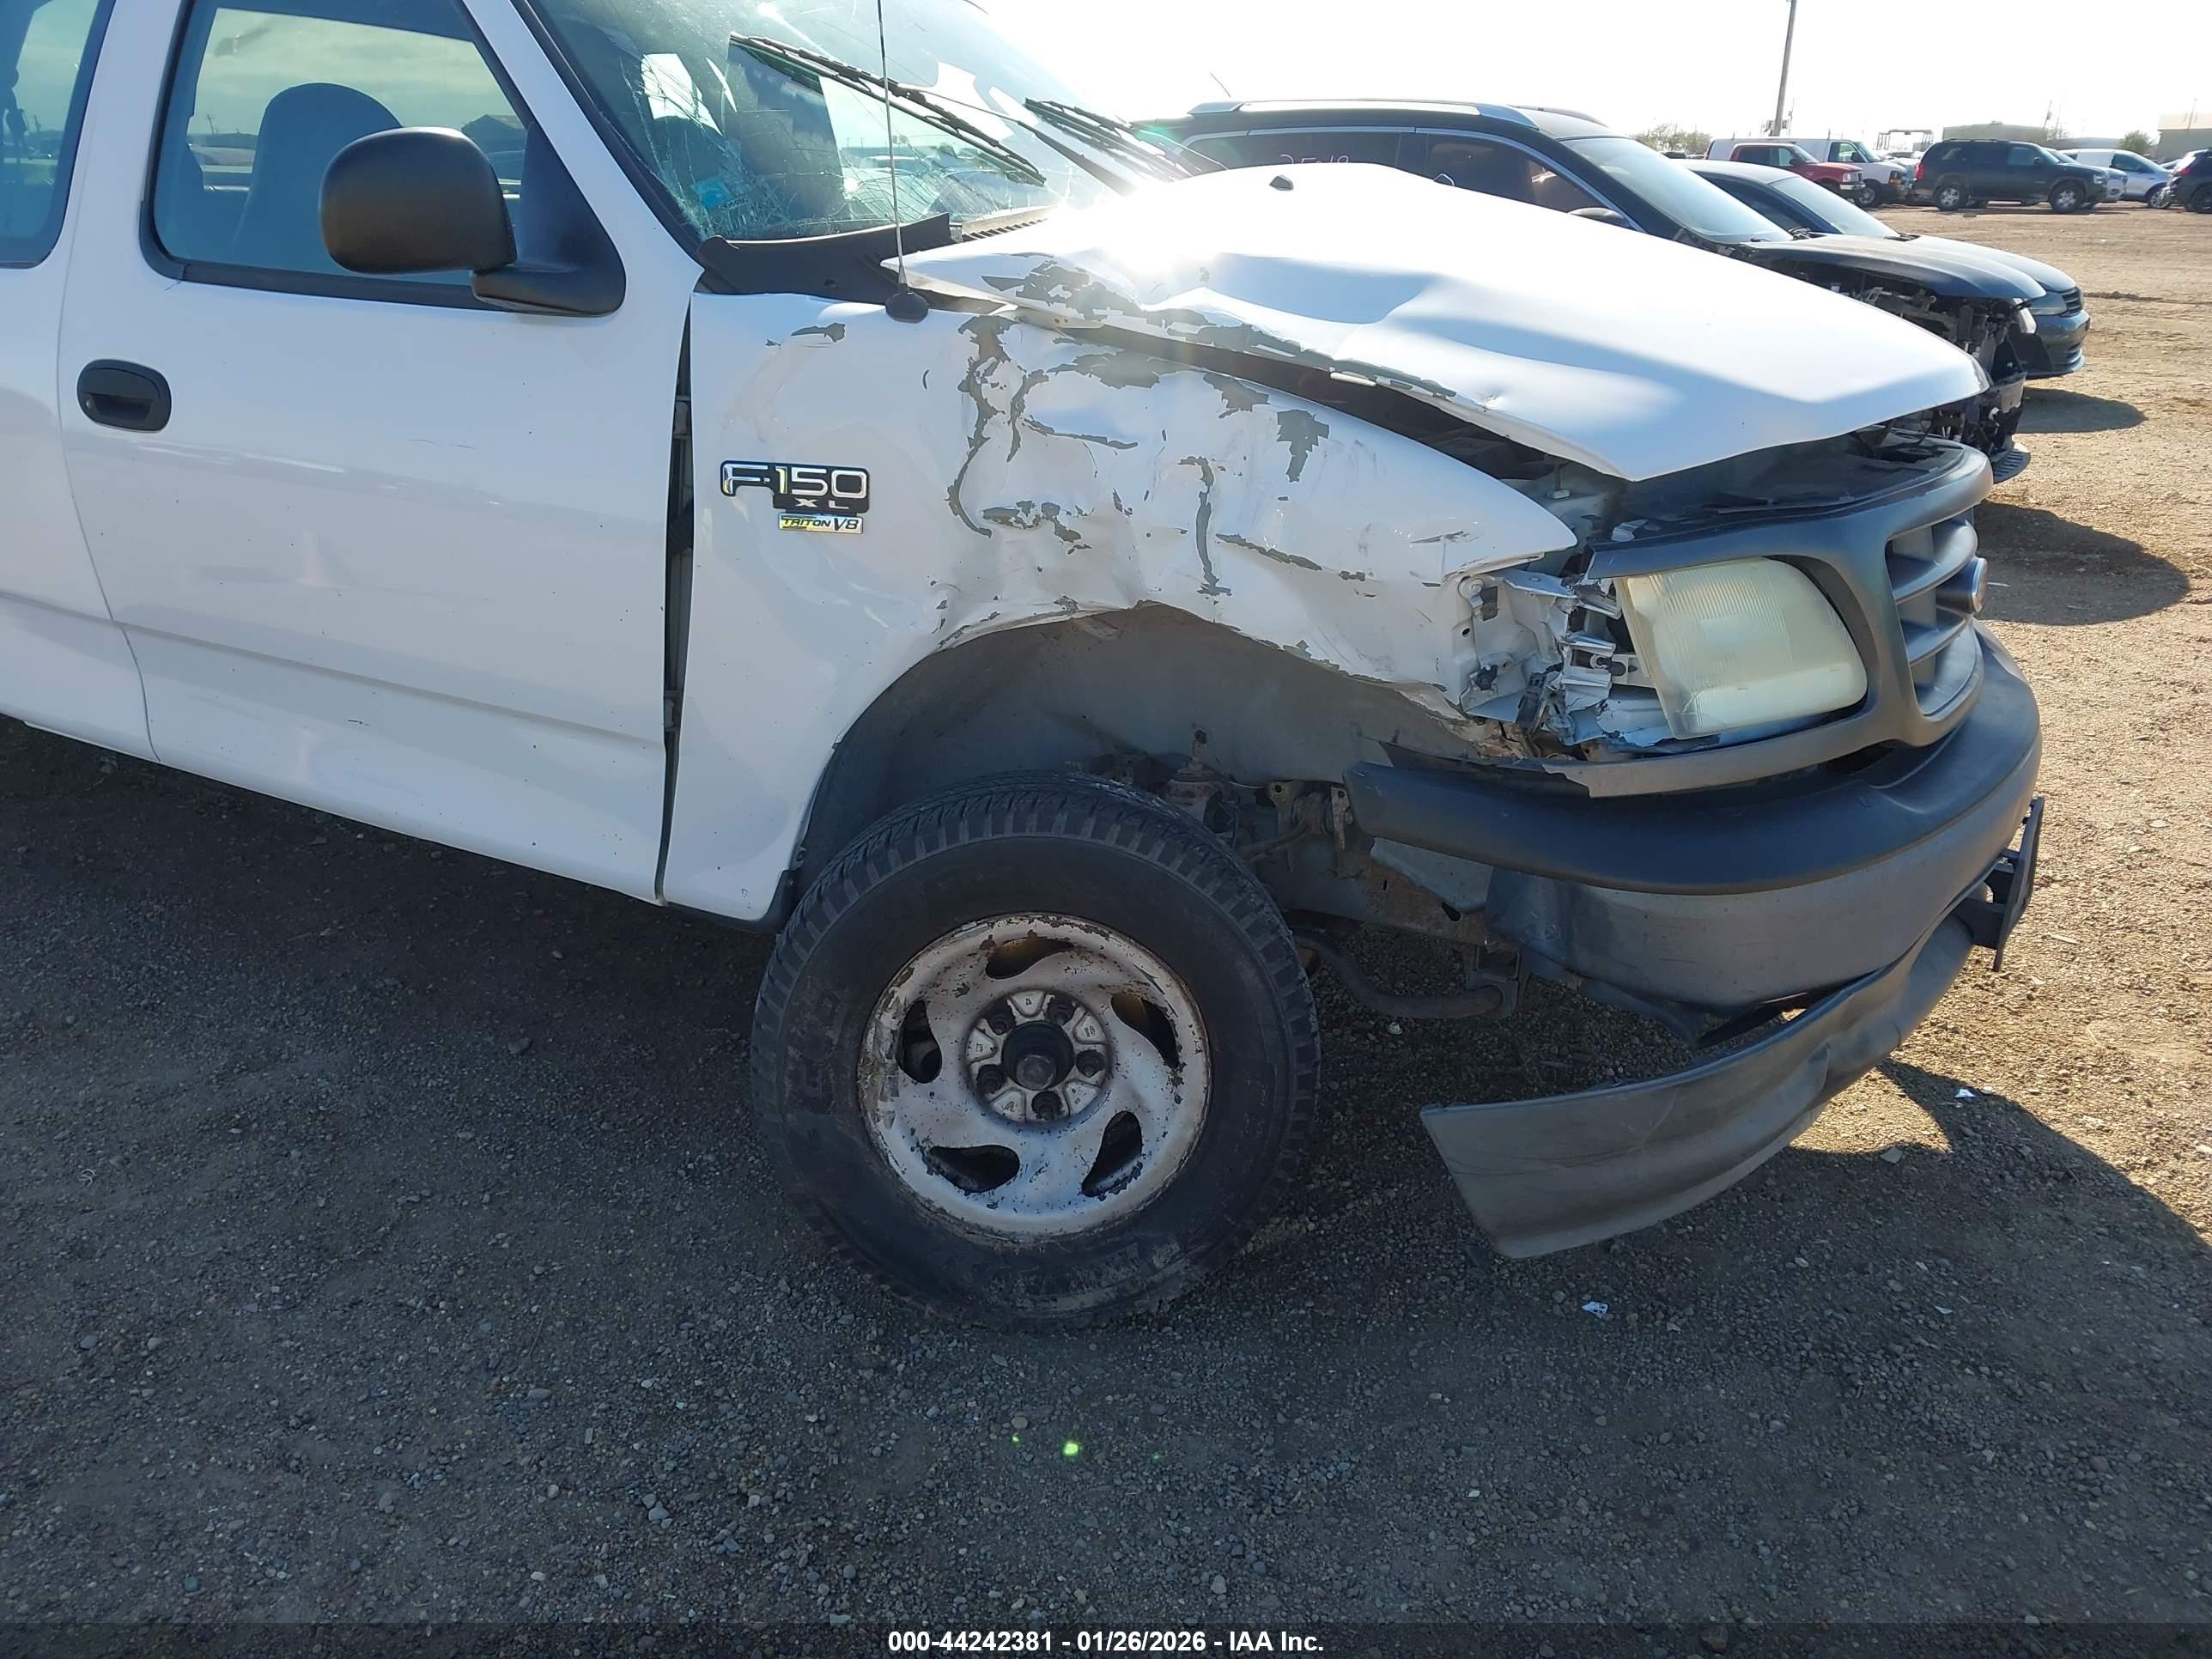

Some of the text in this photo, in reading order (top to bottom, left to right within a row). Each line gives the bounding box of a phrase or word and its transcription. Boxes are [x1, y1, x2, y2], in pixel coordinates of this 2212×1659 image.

[722, 463, 867, 499] F-150
[794, 497, 849, 510] XL
[782, 517, 860, 532] TRITON V8
